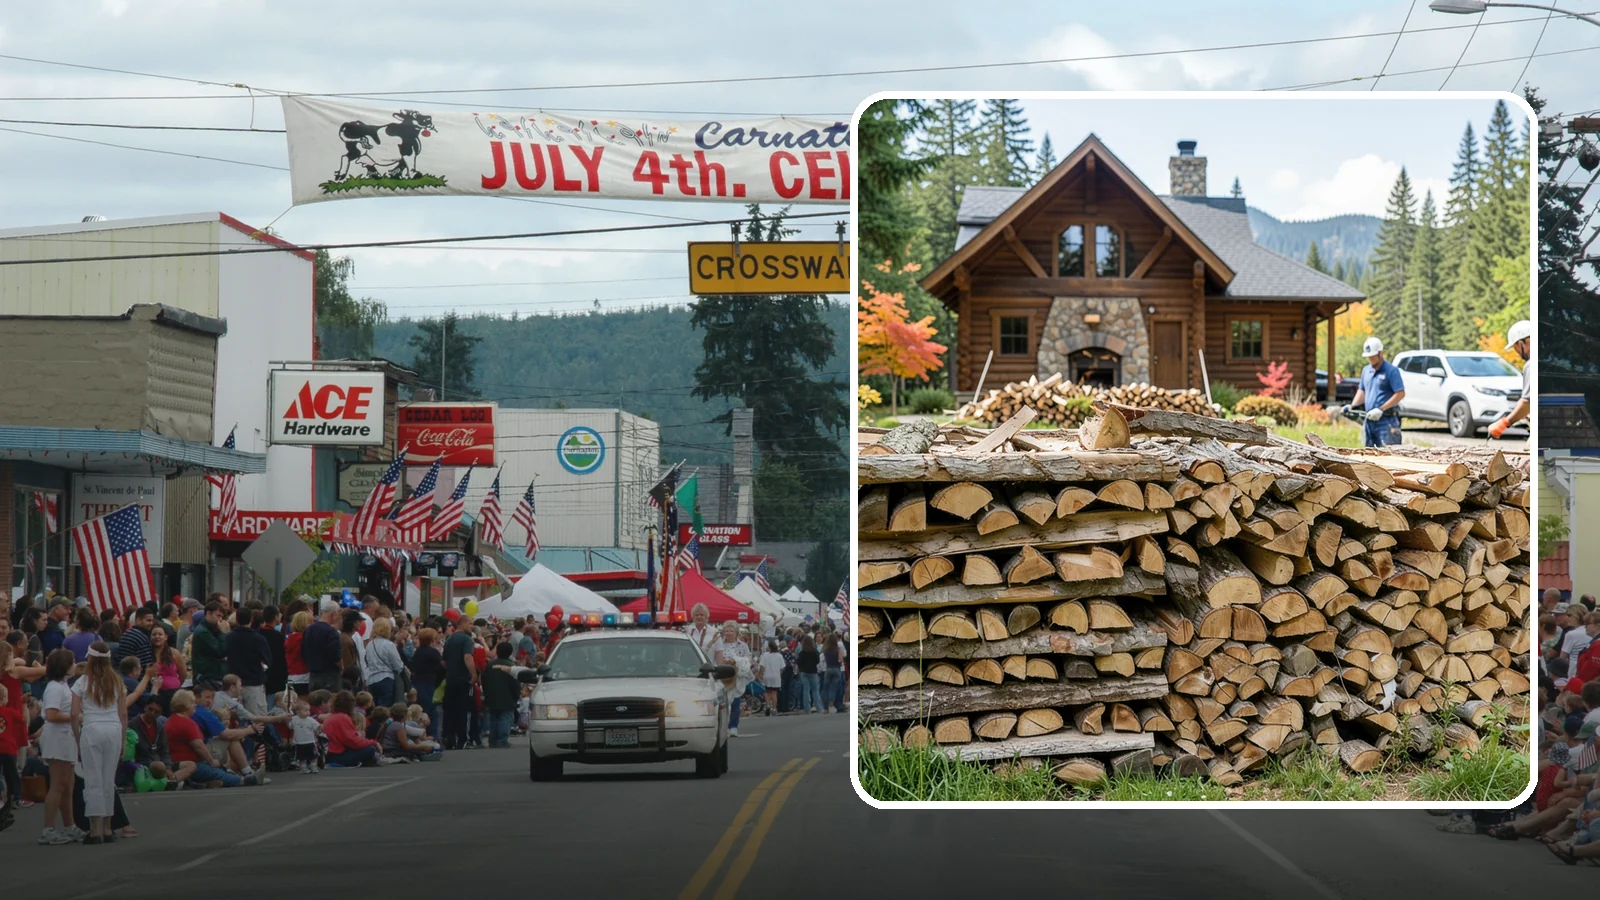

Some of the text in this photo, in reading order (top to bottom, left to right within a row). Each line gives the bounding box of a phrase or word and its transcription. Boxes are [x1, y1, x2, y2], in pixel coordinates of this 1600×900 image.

[694, 121, 850, 150] Carnat
[481, 141, 605, 192] JULY
[632, 150, 746, 198] 4th.
[697, 254, 850, 280] CROSSWA
[282, 380, 373, 420] ACE
[283, 421, 370, 436] Hardware
[96, 485, 124, 494] Vincent
[126, 486, 135, 494] de
[137, 486, 155, 495] Paul
[699, 535, 730, 543] GLASS
